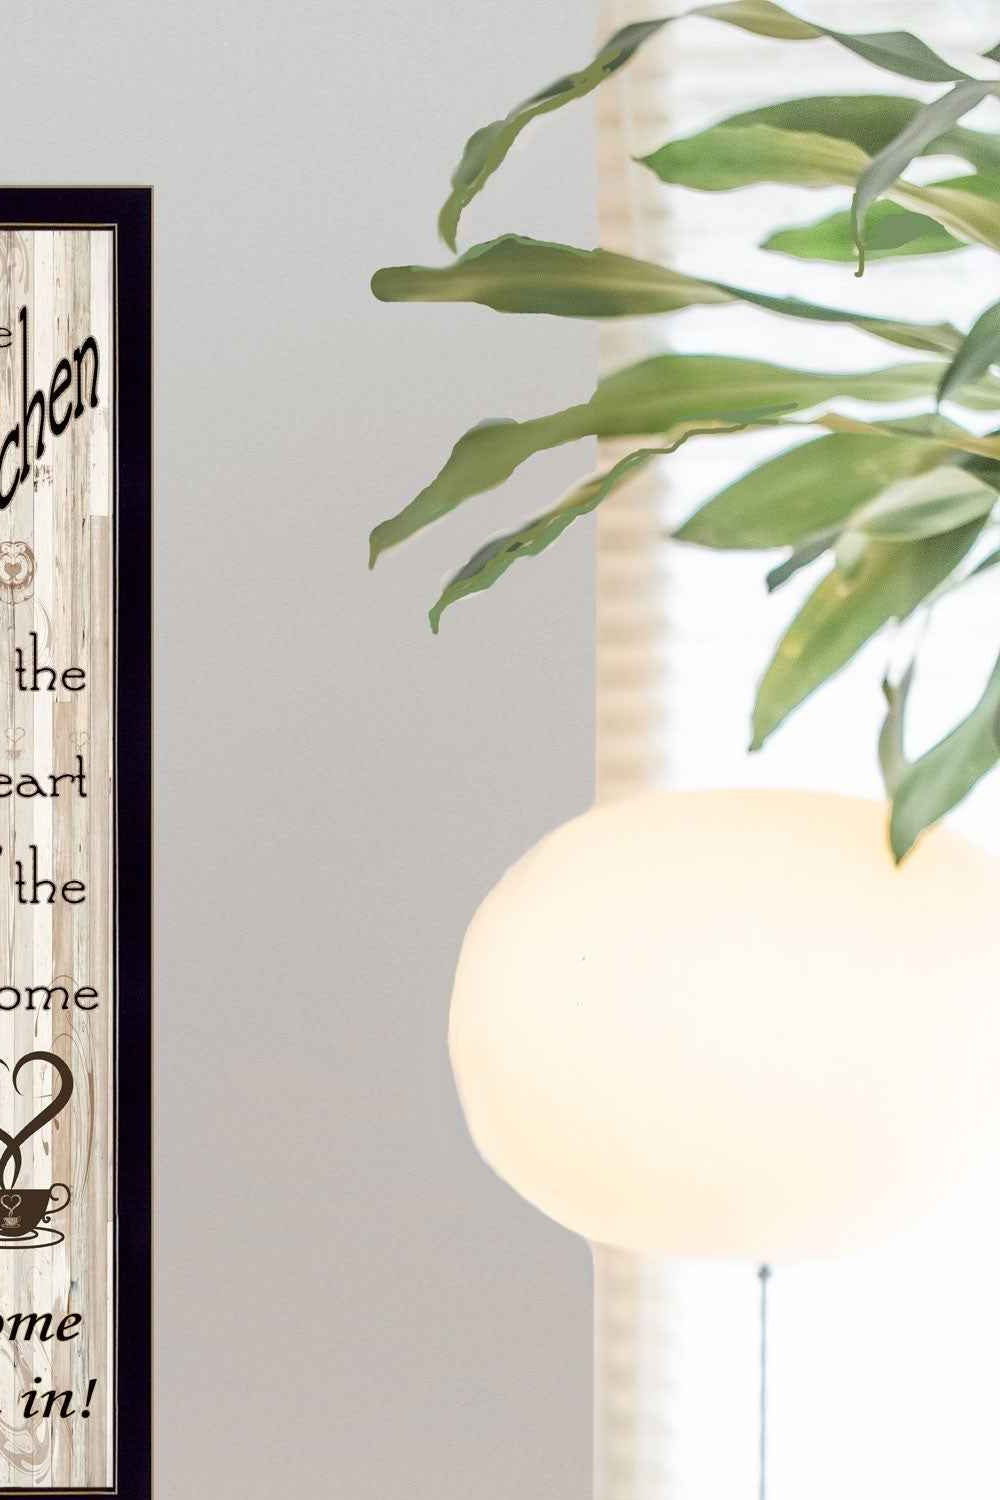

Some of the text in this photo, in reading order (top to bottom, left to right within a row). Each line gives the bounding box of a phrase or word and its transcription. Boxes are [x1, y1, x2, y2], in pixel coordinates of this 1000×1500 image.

[15, 631, 86, 692] the
[15, 844, 86, 905] the
[21, 1376, 98, 1419] in!
